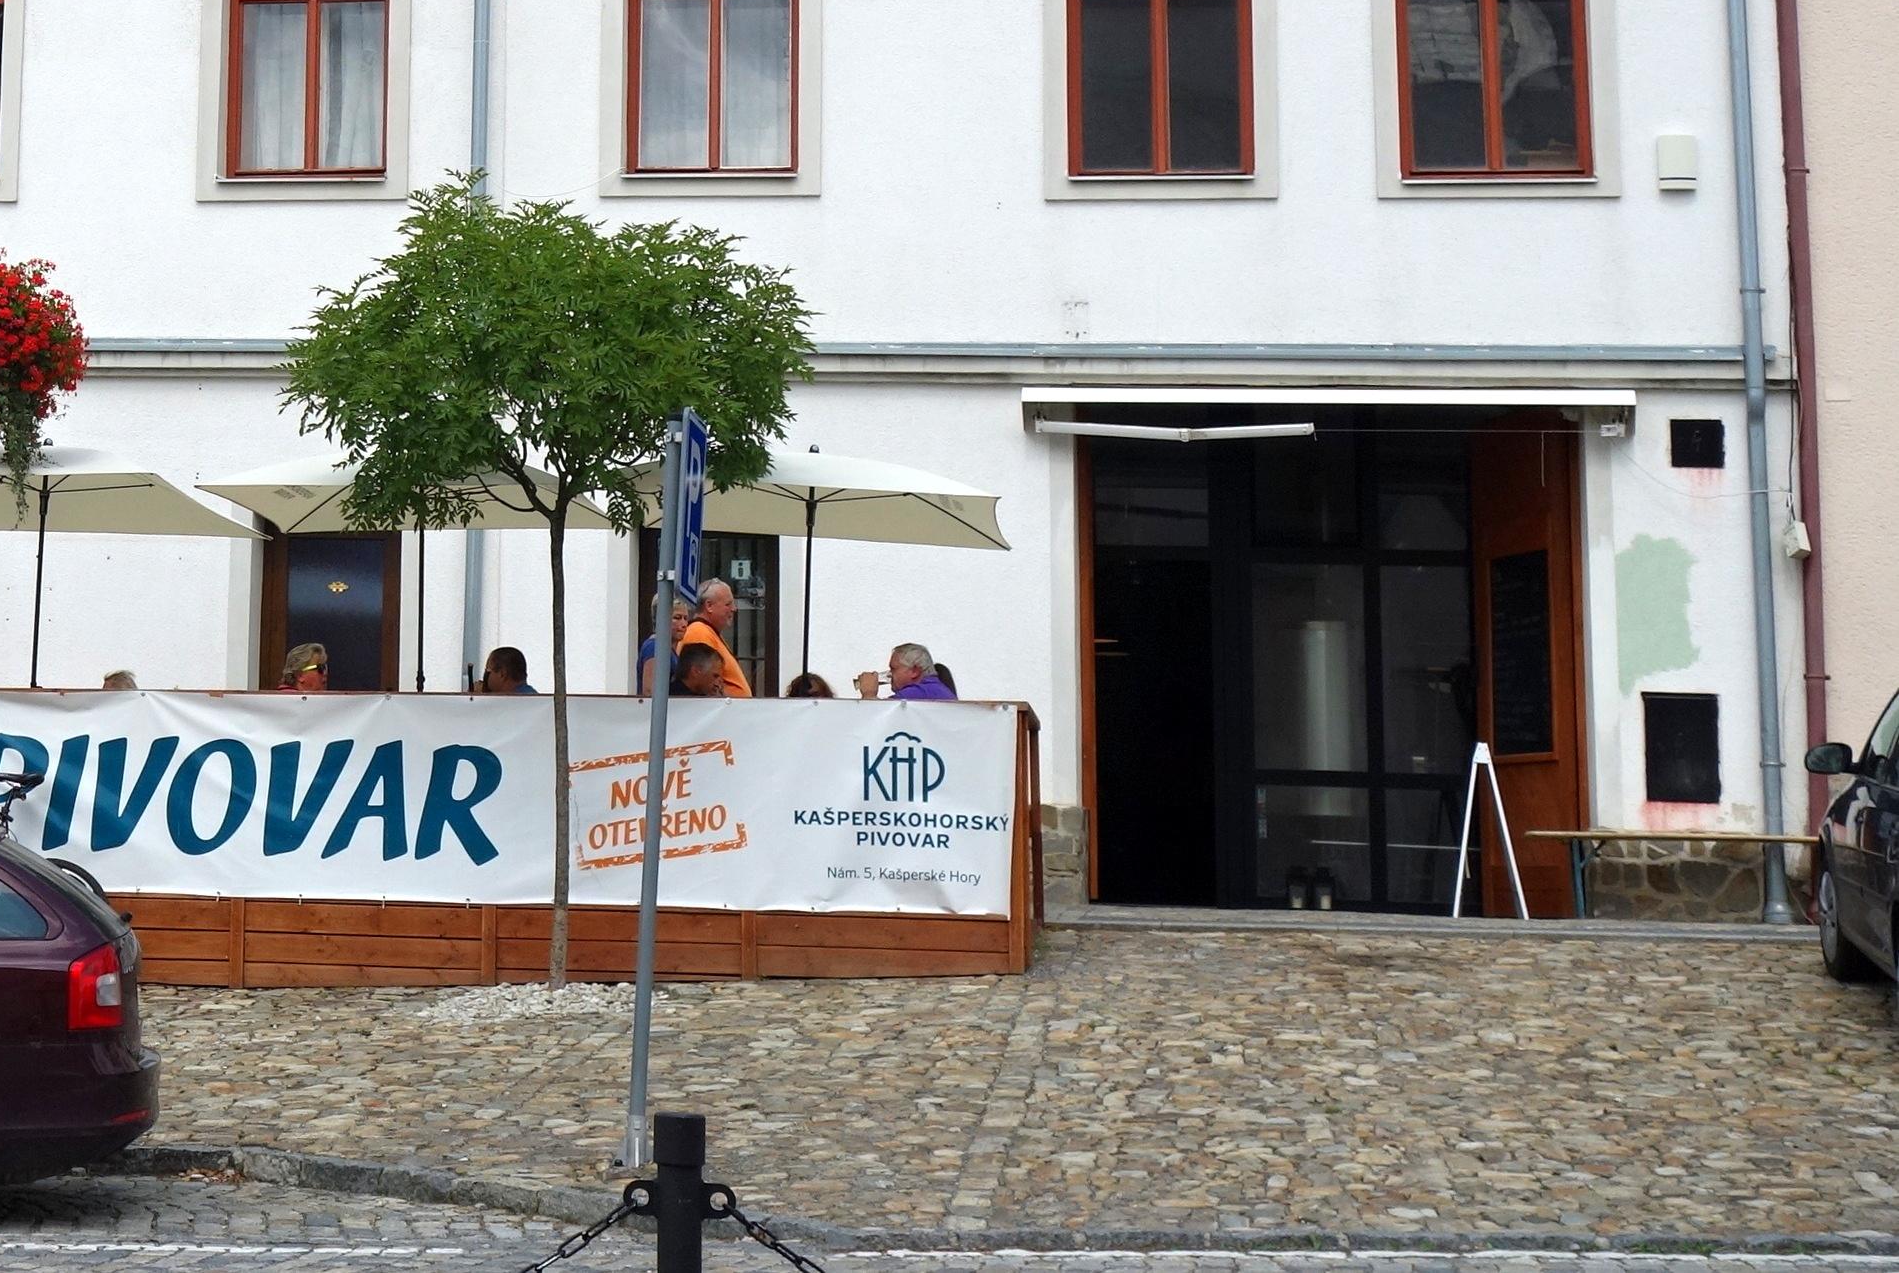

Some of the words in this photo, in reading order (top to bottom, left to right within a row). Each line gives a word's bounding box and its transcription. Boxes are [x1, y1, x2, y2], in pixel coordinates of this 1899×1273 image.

[686, 437, 702, 539] P
[862, 745, 946, 803] KHP
[793, 807, 1010, 832] KAŠPERSKOHORSKÝ
[856, 831, 950, 849] PIVOVAR
[826, 866, 861, 880] Nám.
[863, 867, 876, 881] 5,
[878, 867, 947, 884] Kašperské
[949, 870, 982, 887] Hory
